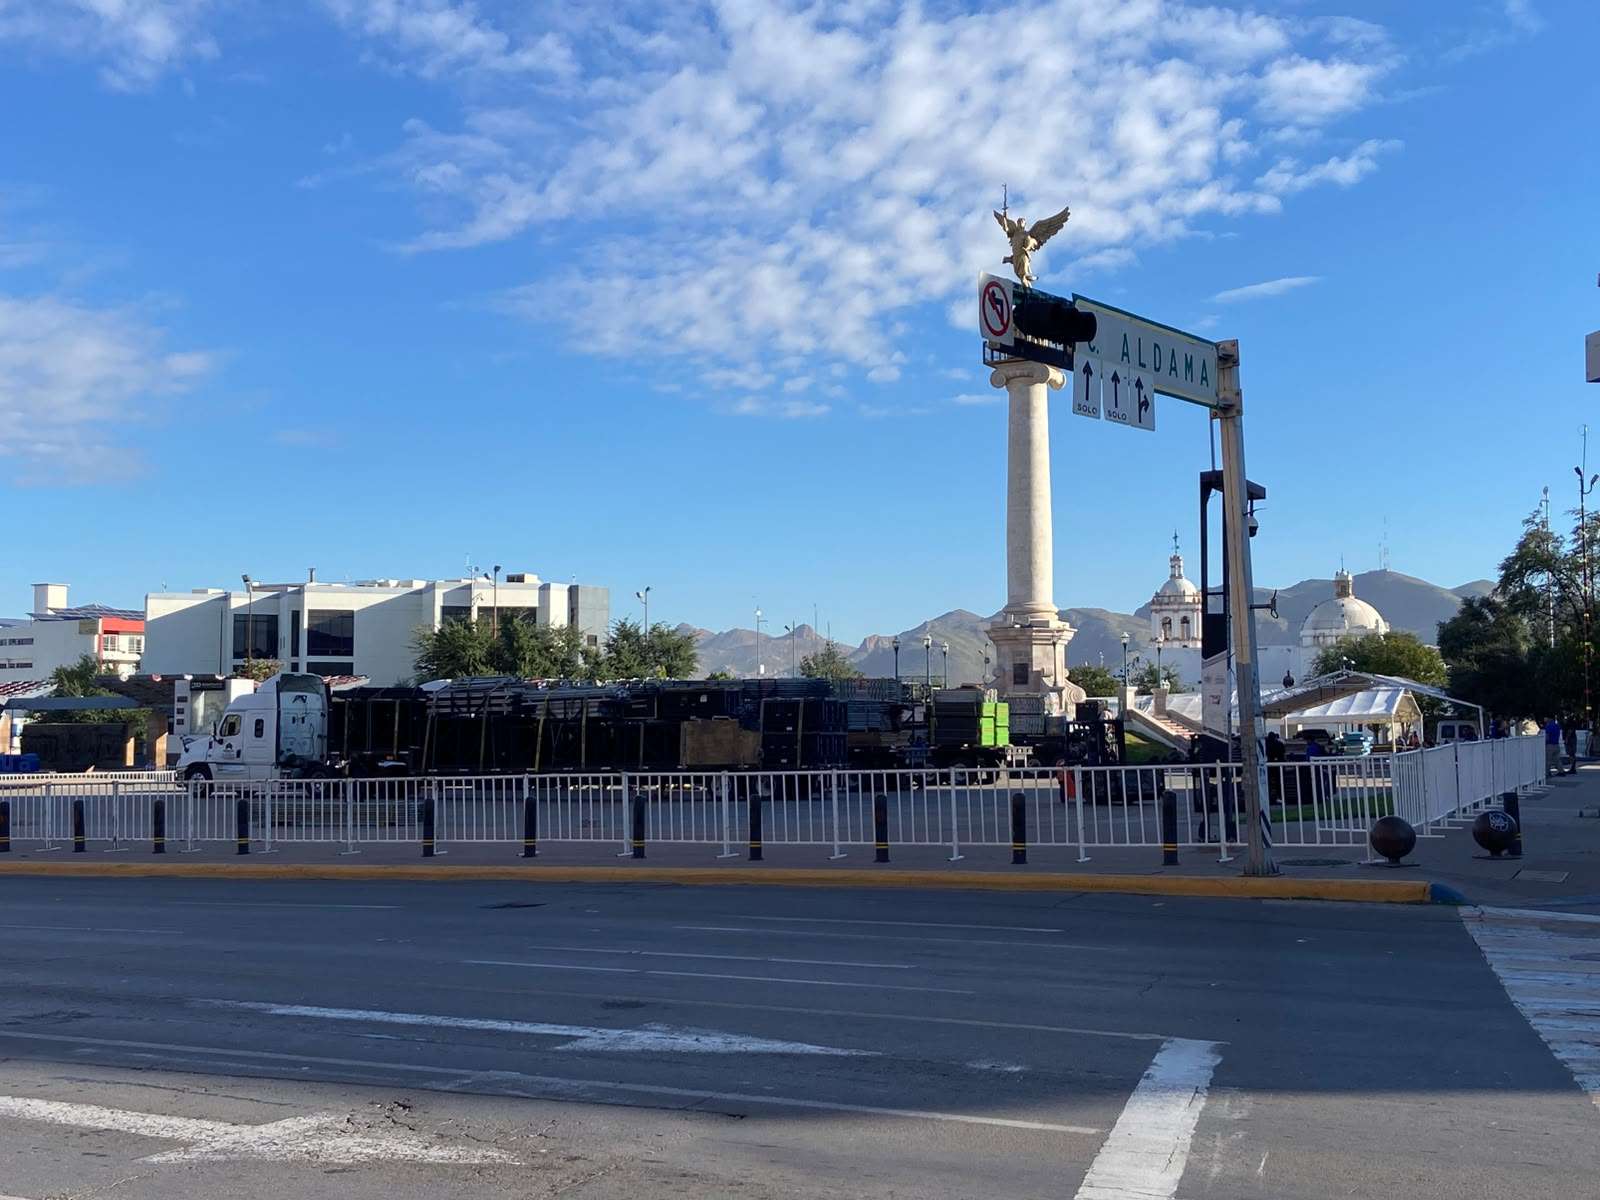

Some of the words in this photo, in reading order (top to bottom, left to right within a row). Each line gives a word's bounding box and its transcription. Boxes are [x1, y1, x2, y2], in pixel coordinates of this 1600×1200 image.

[1121, 332, 1209, 388] ALDAMA
[1077, 402, 1098, 415] SOLO
[1107, 409, 1127, 421] SOLO
